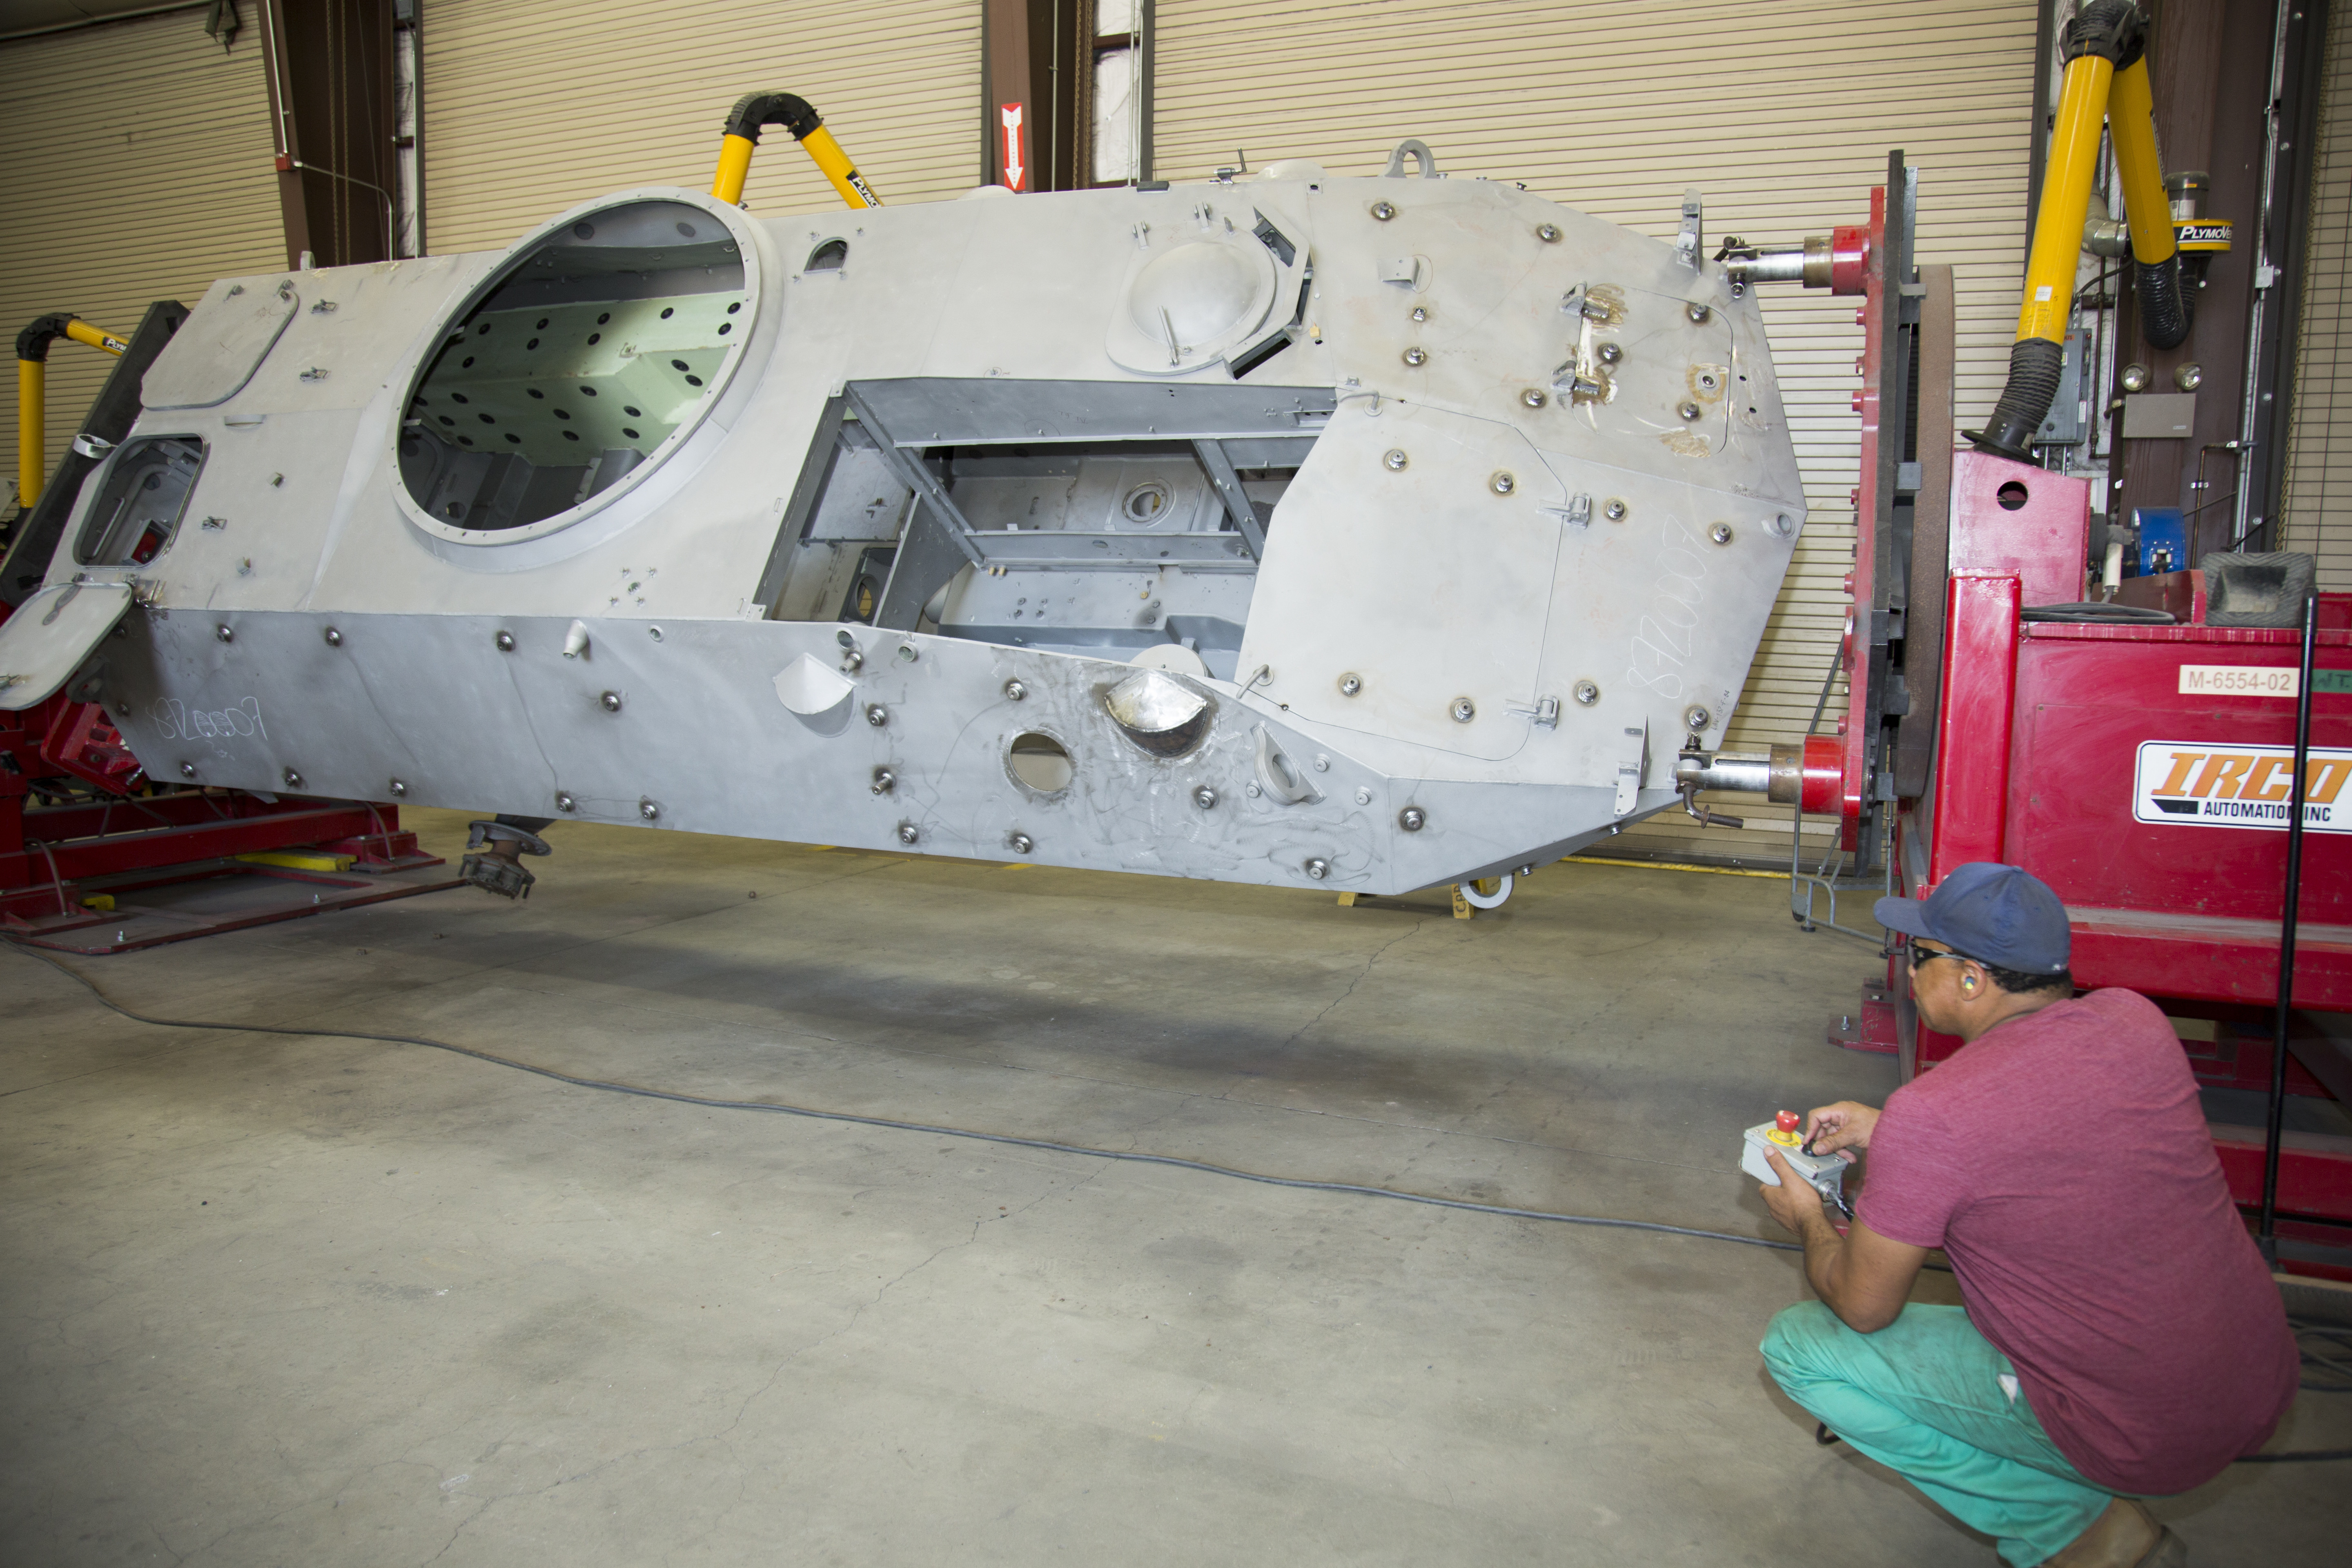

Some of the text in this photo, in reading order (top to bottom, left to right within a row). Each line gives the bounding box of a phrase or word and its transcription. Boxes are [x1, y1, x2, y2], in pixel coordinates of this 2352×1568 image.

[852, 176, 881, 209] PLYMO
[2188, 670, 2291, 692] M-6554-02
[2151, 752, 2352, 804] IRCO
[2305, 806, 2331, 822] INC
